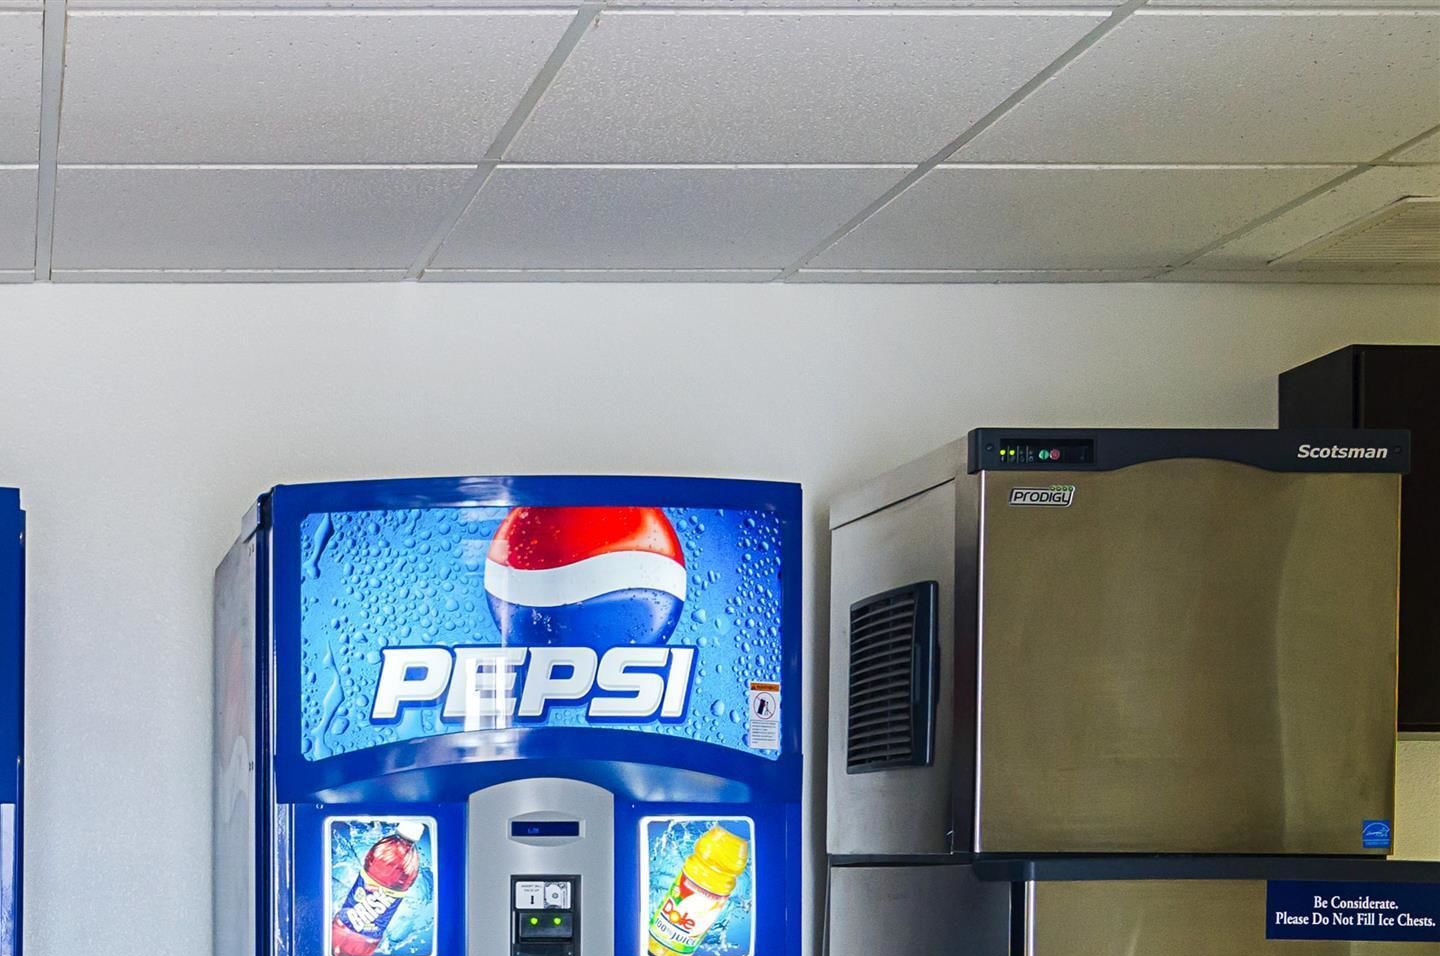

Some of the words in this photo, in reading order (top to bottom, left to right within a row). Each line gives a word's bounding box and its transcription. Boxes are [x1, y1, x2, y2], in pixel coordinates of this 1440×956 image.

[1297, 444, 1389, 459] Scotsman
[371, 646, 696, 720] PEPSI
[1313, 895, 1328, 909] Be
[1330, 895, 1399, 910] Considerate.
[662, 899, 696, 930] Dole
[1275, 911, 1310, 925] Please
[1312, 912, 1330, 926] Do
[1332, 912, 1354, 926] Not
[1356, 913, 1375, 926] Fill
[1378, 913, 1395, 926] Ice
[1397, 913, 1436, 927] Chests.
